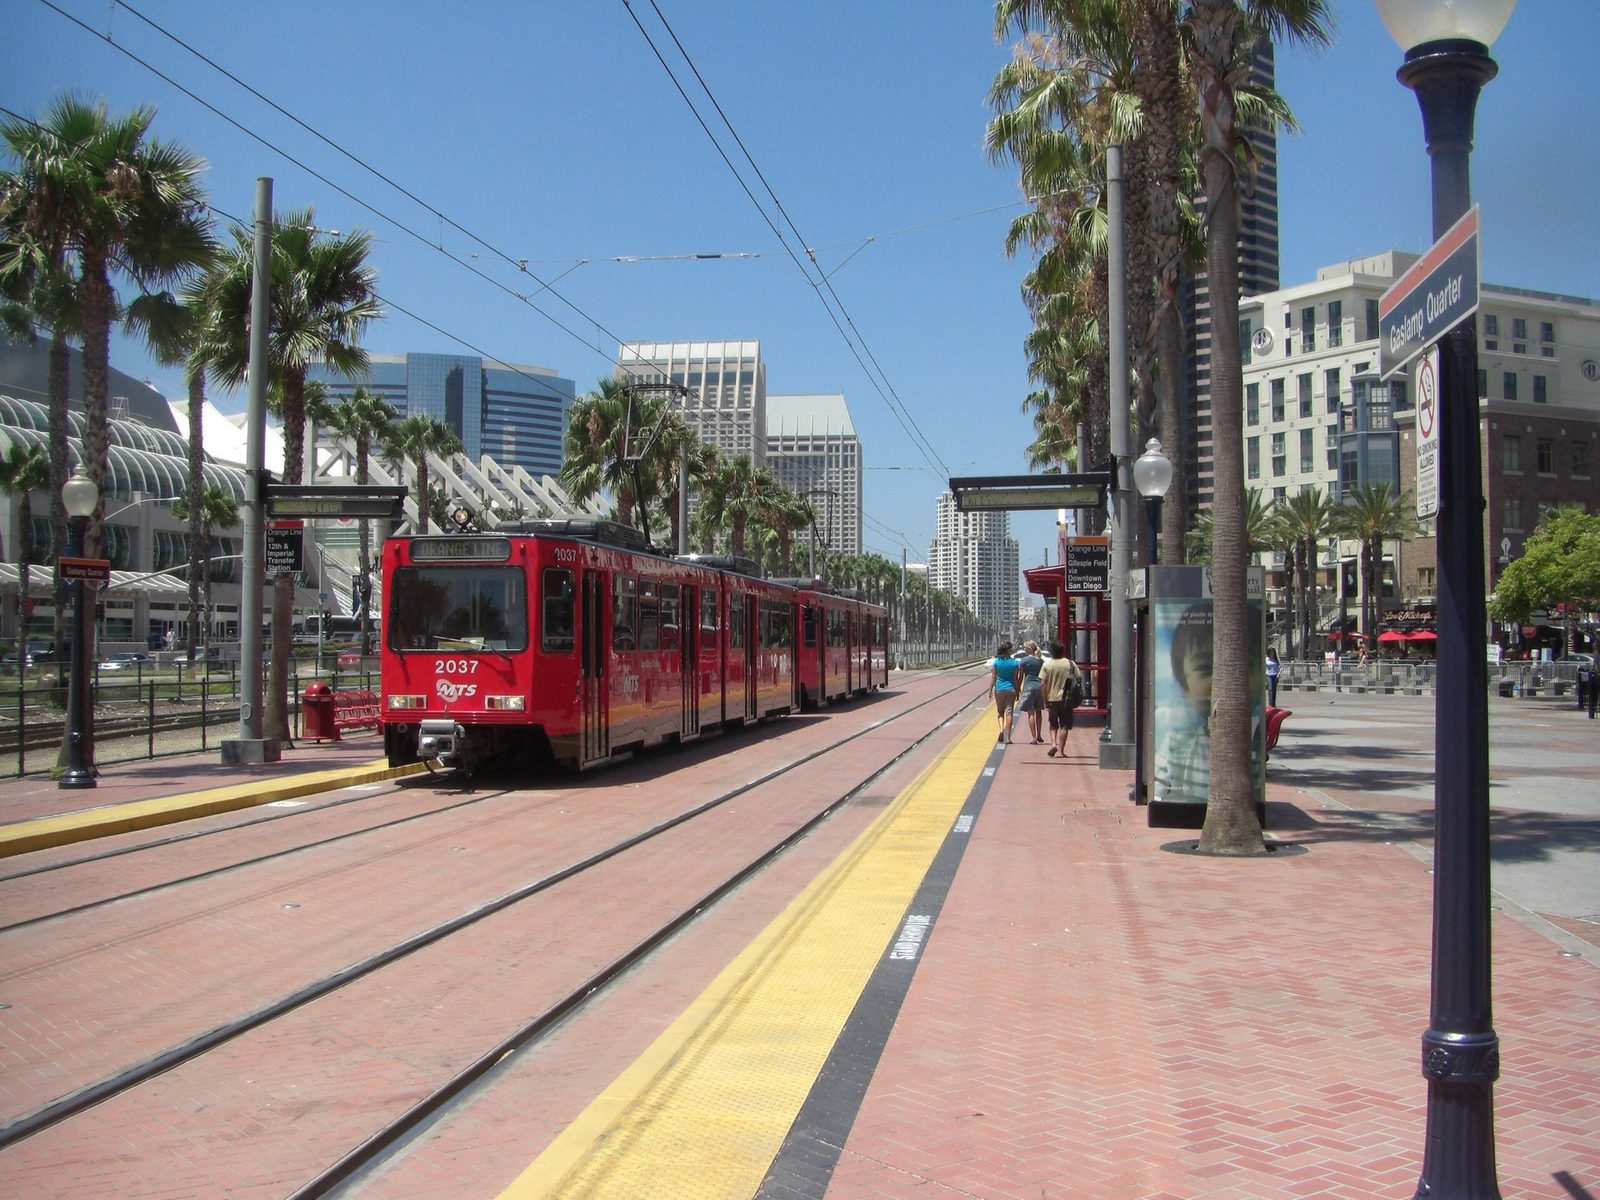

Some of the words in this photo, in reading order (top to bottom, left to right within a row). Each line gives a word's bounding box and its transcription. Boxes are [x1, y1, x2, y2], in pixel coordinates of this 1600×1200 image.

[1389, 308, 1424, 354] Gaslamp
[1426, 275, 1463, 325] Quarter
[267, 529, 289, 537] Orange
[421, 542, 469, 556] ORANGE
[1067, 545, 1092, 554] Orange
[267, 550, 295, 558] Imperial
[554, 548, 577, 562] 2037
[1067, 559, 1092, 568] Gillespie
[1093, 559, 1107, 567] Field
[1067, 567, 1078, 575] via
[1067, 574, 1102, 582] Downtown
[1082, 582, 1103, 590] Diego
[435, 660, 479, 674] 2037
[437, 683, 478, 697] MTS
